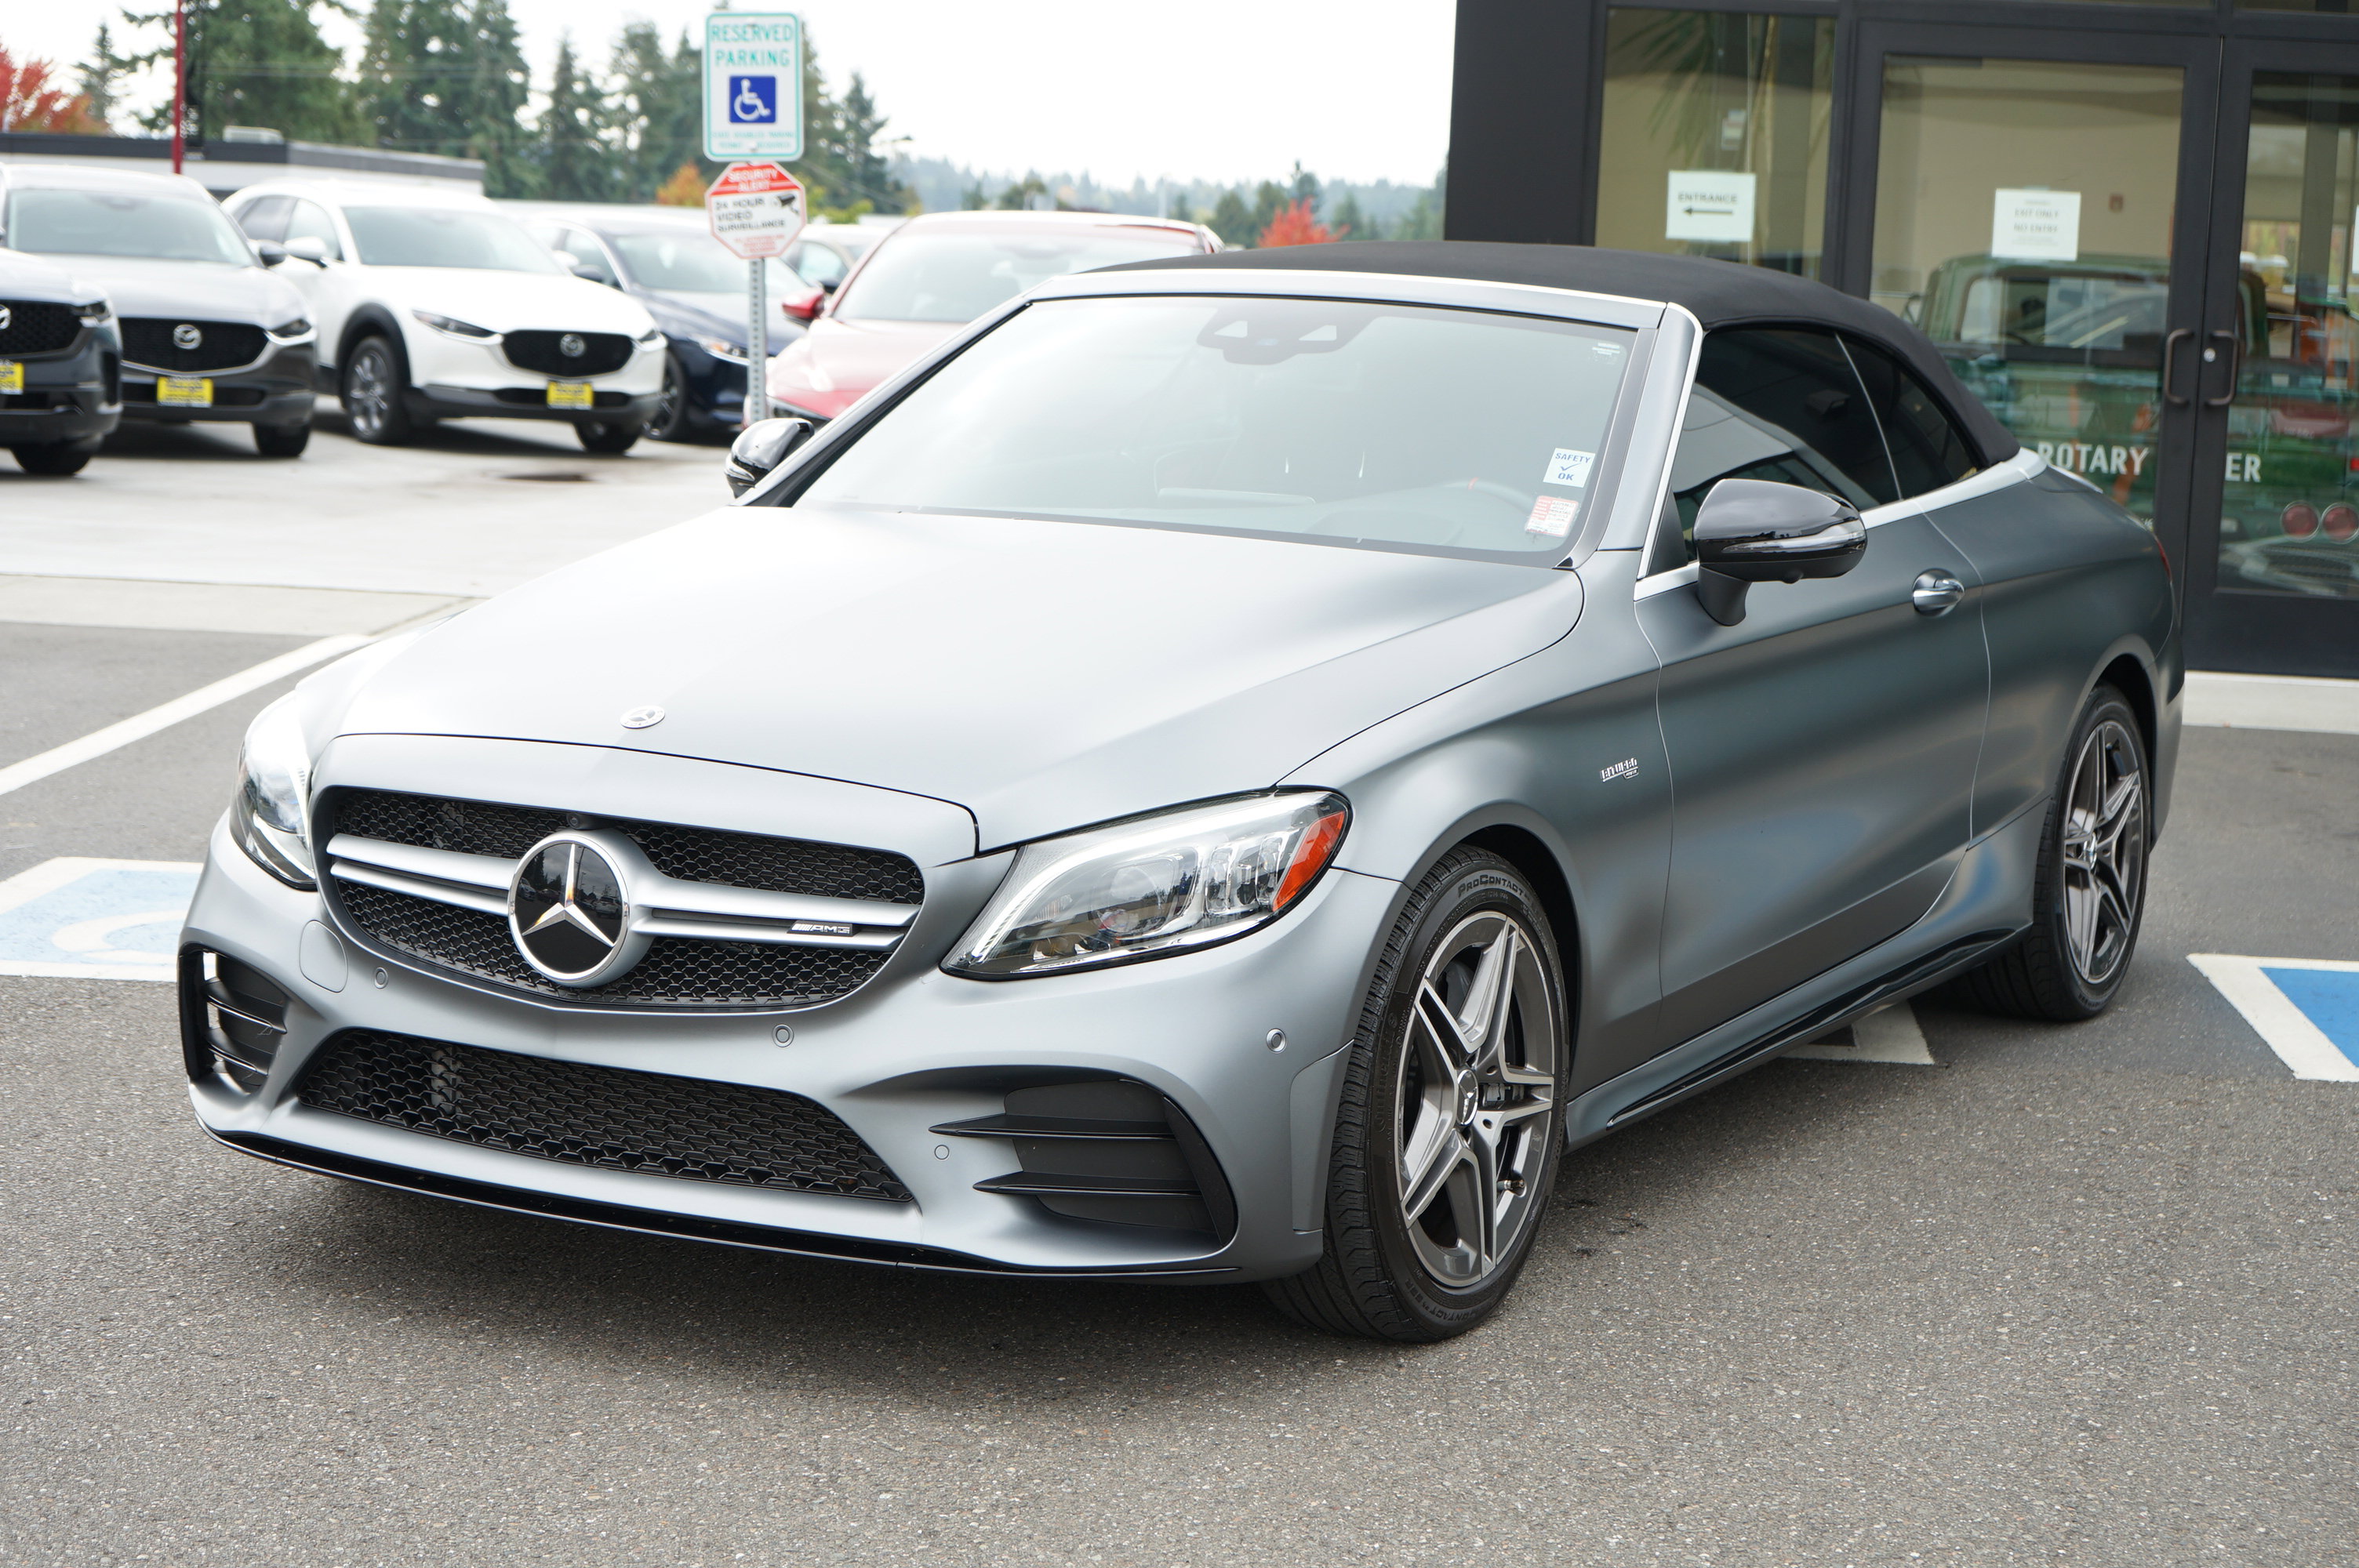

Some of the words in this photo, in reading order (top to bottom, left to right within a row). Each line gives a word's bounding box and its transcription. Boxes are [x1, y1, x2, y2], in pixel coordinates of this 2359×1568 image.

[711, 24, 793, 42] RESERVED
[715, 48, 790, 67] PARKING
[726, 167, 778, 183] SECURITY
[737, 179, 770, 194] ALERT
[731, 197, 765, 209] HOUR
[1677, 193, 1738, 203] ENTRANCE
[716, 210, 753, 222] VIDEO
[1555, 452, 1590, 463] SAFETY
[2037, 441, 2150, 476] ROTARY
[1558, 472, 1575, 481] OK
[811, 925, 850, 934] AMG
